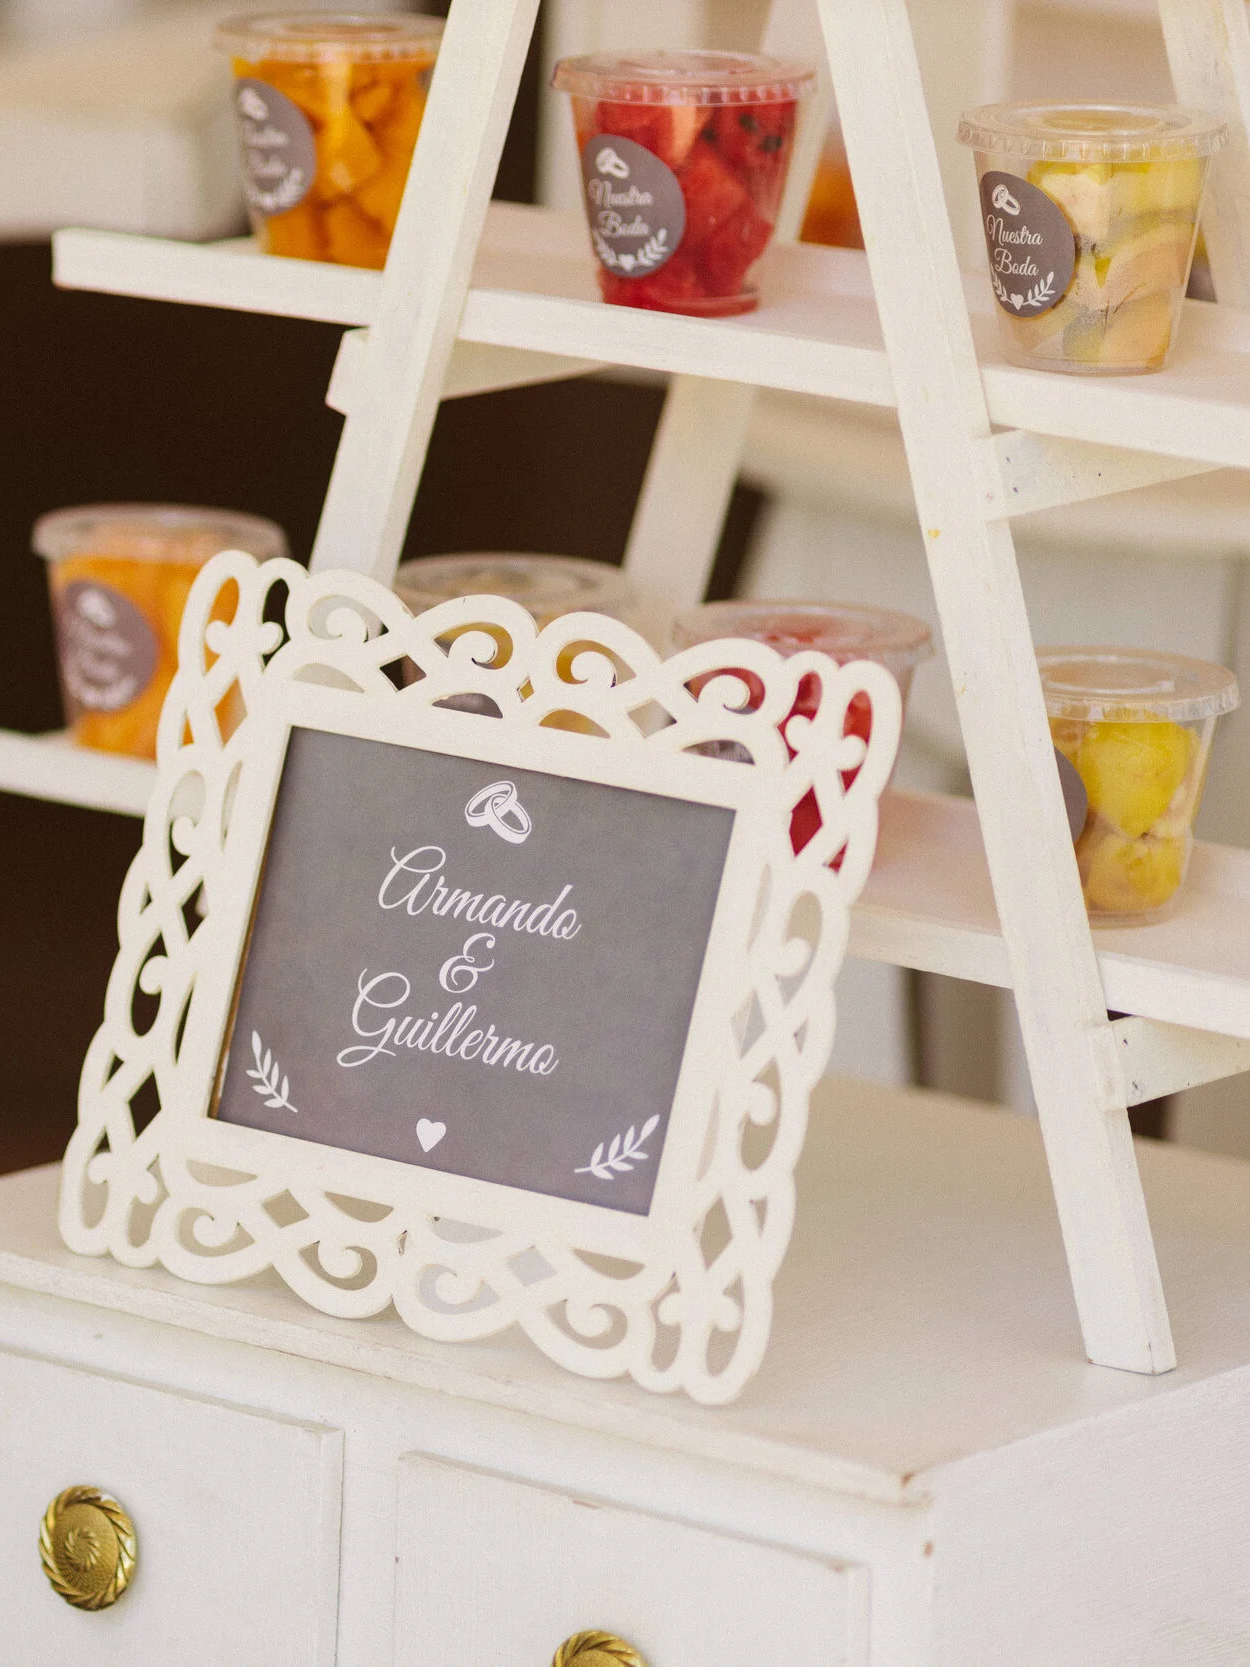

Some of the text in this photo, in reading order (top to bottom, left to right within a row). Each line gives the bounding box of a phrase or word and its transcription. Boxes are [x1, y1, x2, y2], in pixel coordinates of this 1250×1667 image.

[986, 214, 1043, 246] Nuestra
[994, 248, 1039, 276] Boda
[378, 845, 582, 940] Armando
[438, 932, 496, 994] &
[336, 968, 559, 1075] Guillermo
